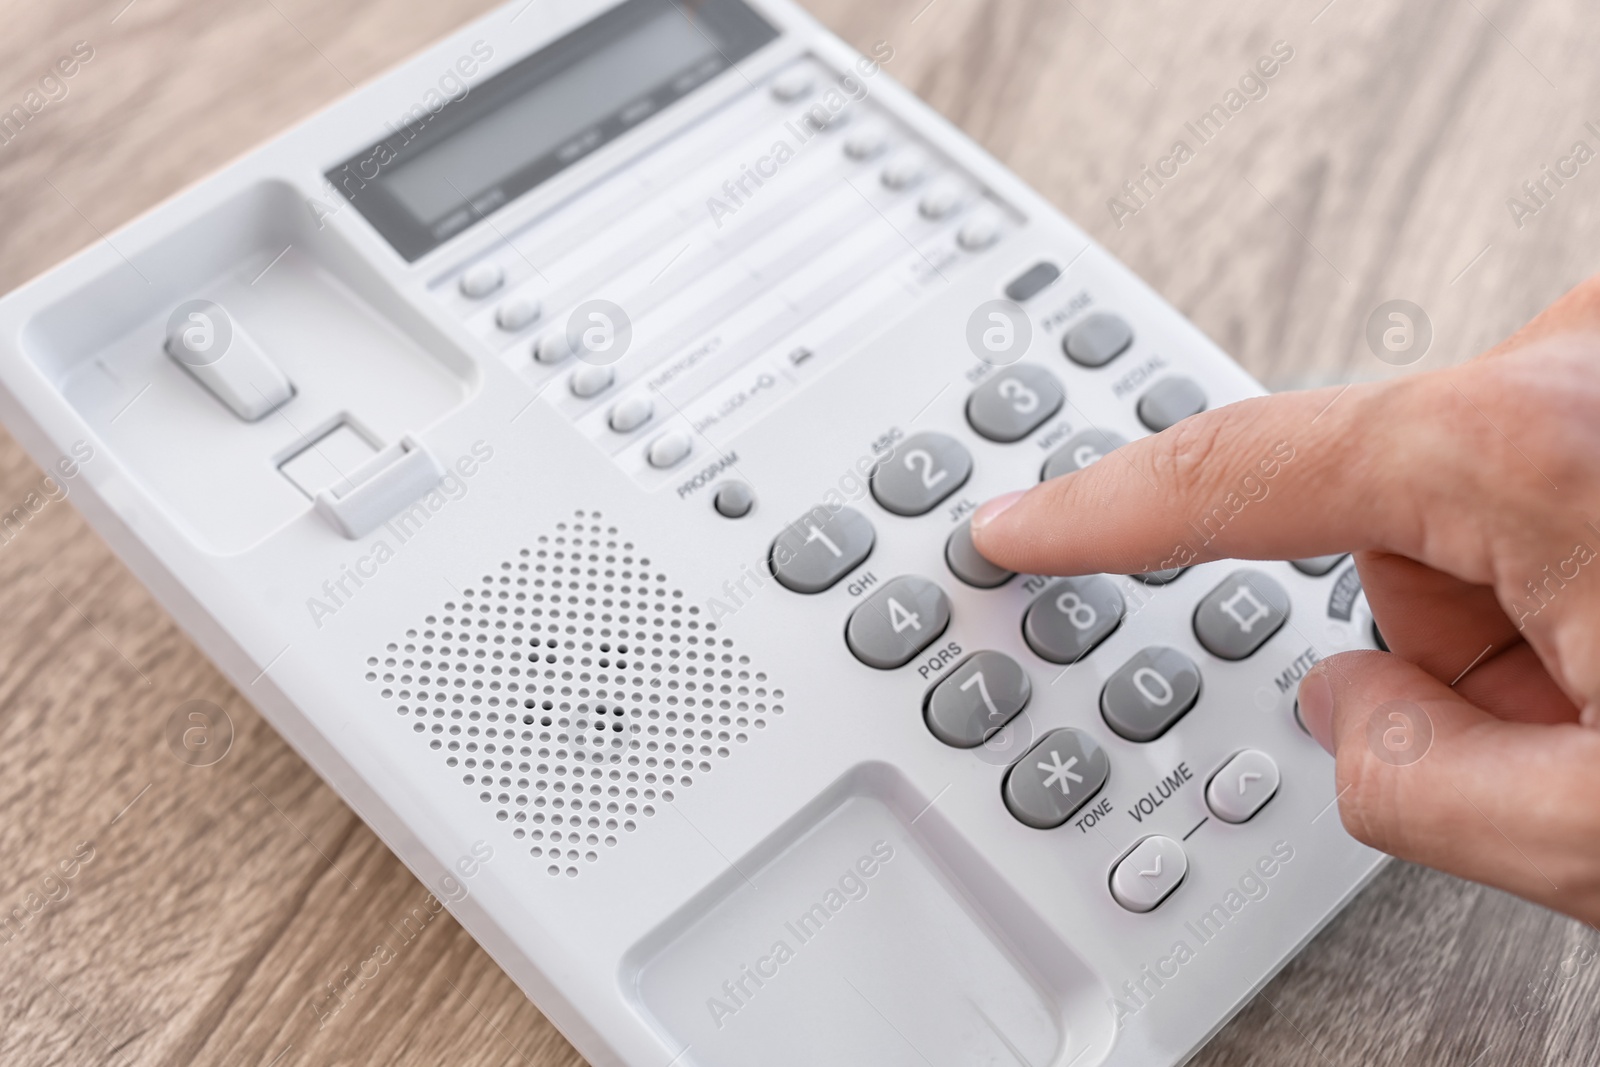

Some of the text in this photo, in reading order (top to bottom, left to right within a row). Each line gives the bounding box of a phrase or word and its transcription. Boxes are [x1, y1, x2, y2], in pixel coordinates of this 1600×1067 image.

[1041, 289, 1093, 334] PAUSE
[1111, 354, 1170, 399] REDIAL
[998, 378, 1040, 414] 3
[871, 427, 903, 453] ABC
[1037, 421, 1073, 451] MNO
[676, 450, 739, 499] PROGRAM
[904, 450, 947, 489] 2
[949, 498, 977, 522] JKL
[807, 524, 843, 558] 1
[846, 572, 878, 598] GHI
[1022, 576, 1053, 594] TU
[887, 597, 922, 634] 4
[1056, 591, 1097, 630] 8
[917, 642, 962, 680] PQRS
[1274, 645, 1320, 694] MUTE
[960, 671, 1000, 715] 7
[1132, 667, 1174, 706] 0
[1128, 762, 1194, 824] VOLUME
[1075, 798, 1113, 835] TONE
